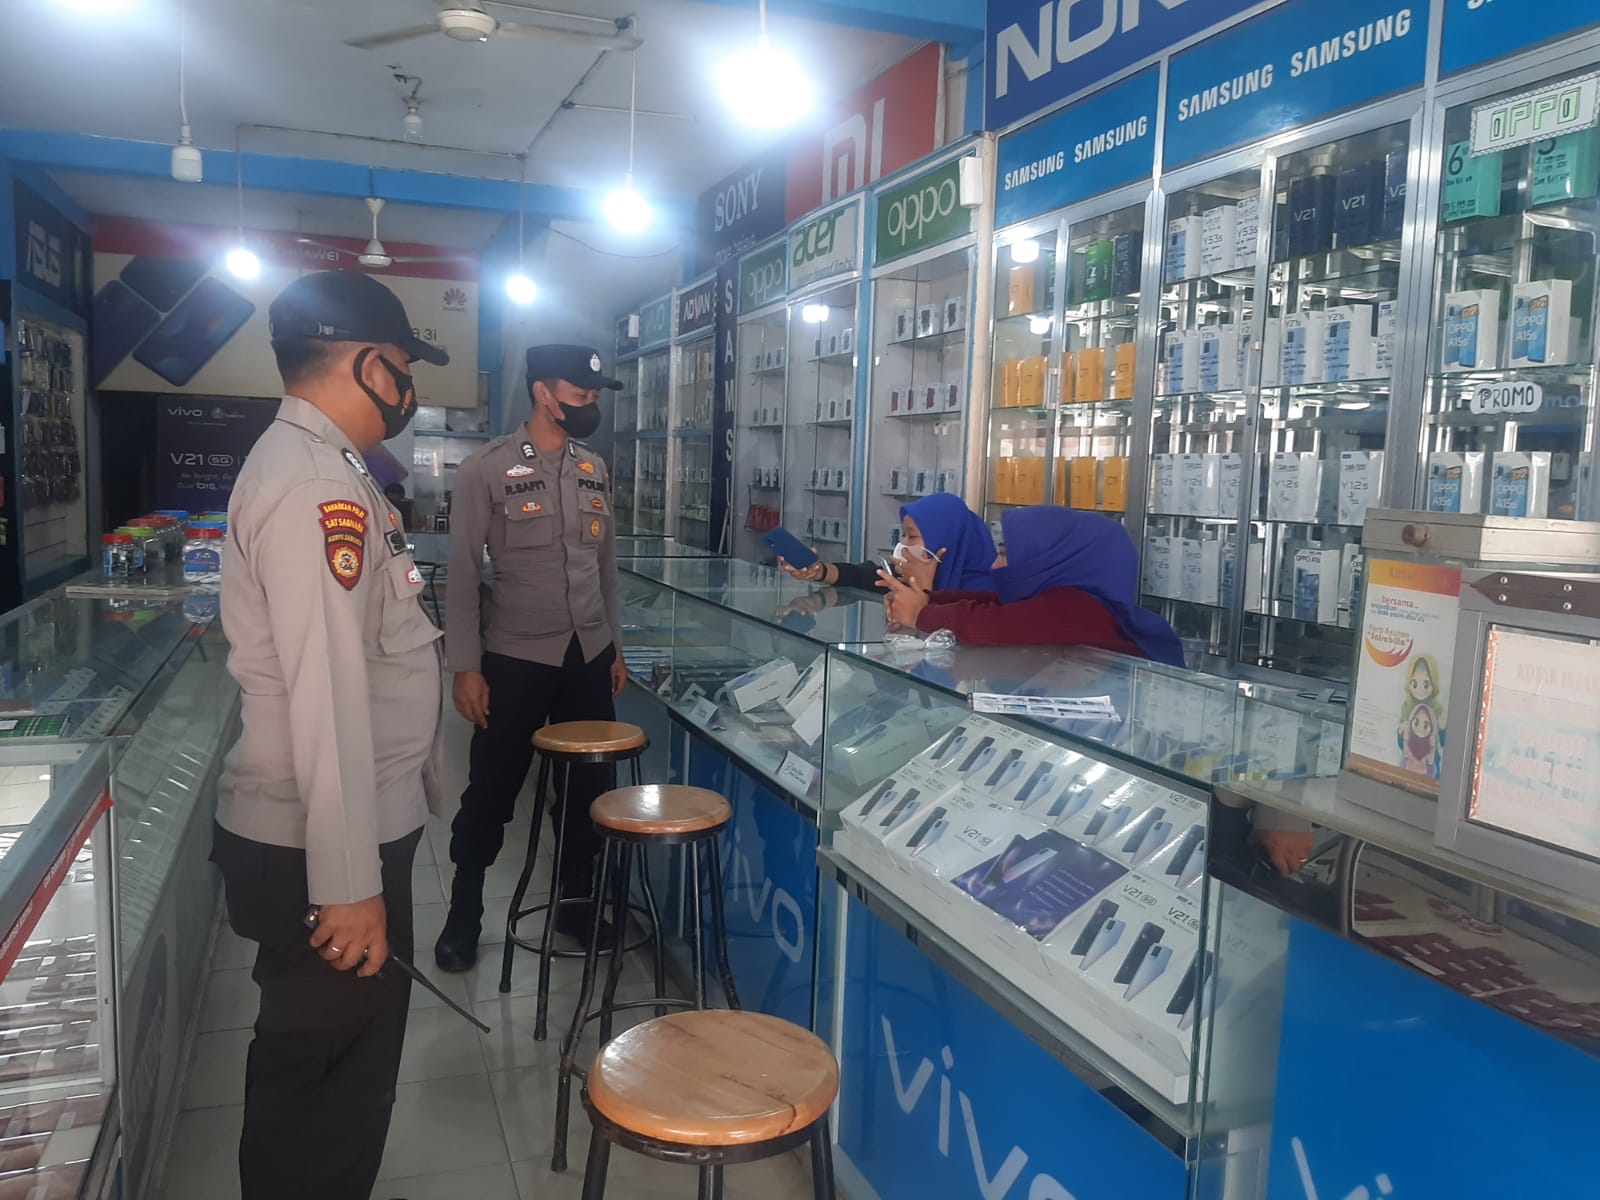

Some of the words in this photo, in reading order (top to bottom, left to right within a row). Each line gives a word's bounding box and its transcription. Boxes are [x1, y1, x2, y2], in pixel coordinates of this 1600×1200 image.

[1178, 63, 1274, 122] SAMSUNG
[1290, 8, 1411, 78] SAMSUNG
[1490, 87, 1581, 142] OPPO
[1004, 151, 1065, 191] SAMSUNG
[1074, 115, 1148, 163] SAMSUNG
[1389, 183, 1407, 198] V2
[714, 168, 762, 233] SONY
[1342, 194, 1365, 211] V21
[887, 178, 957, 247] oppo
[1294, 207, 1317, 222] V21
[792, 209, 845, 268] acer
[748, 258, 785, 305] oppo
[683, 291, 711, 322] ADVAN
[1448, 322, 1475, 334] OPPO
[1516, 316, 1545, 328] OPPO
[1515, 330, 1538, 342] A15s
[1477, 385, 1535, 409] PROMO
[168, 406, 203, 417] vivo
[170, 453, 204, 466] V21
[1432, 483, 1459, 494] OPPO
[1495, 484, 1525, 496] OPPO
[325, 519, 338, 529] SAT
[1123, 884, 1143, 898] V21
[1168, 906, 1190, 922] V21
